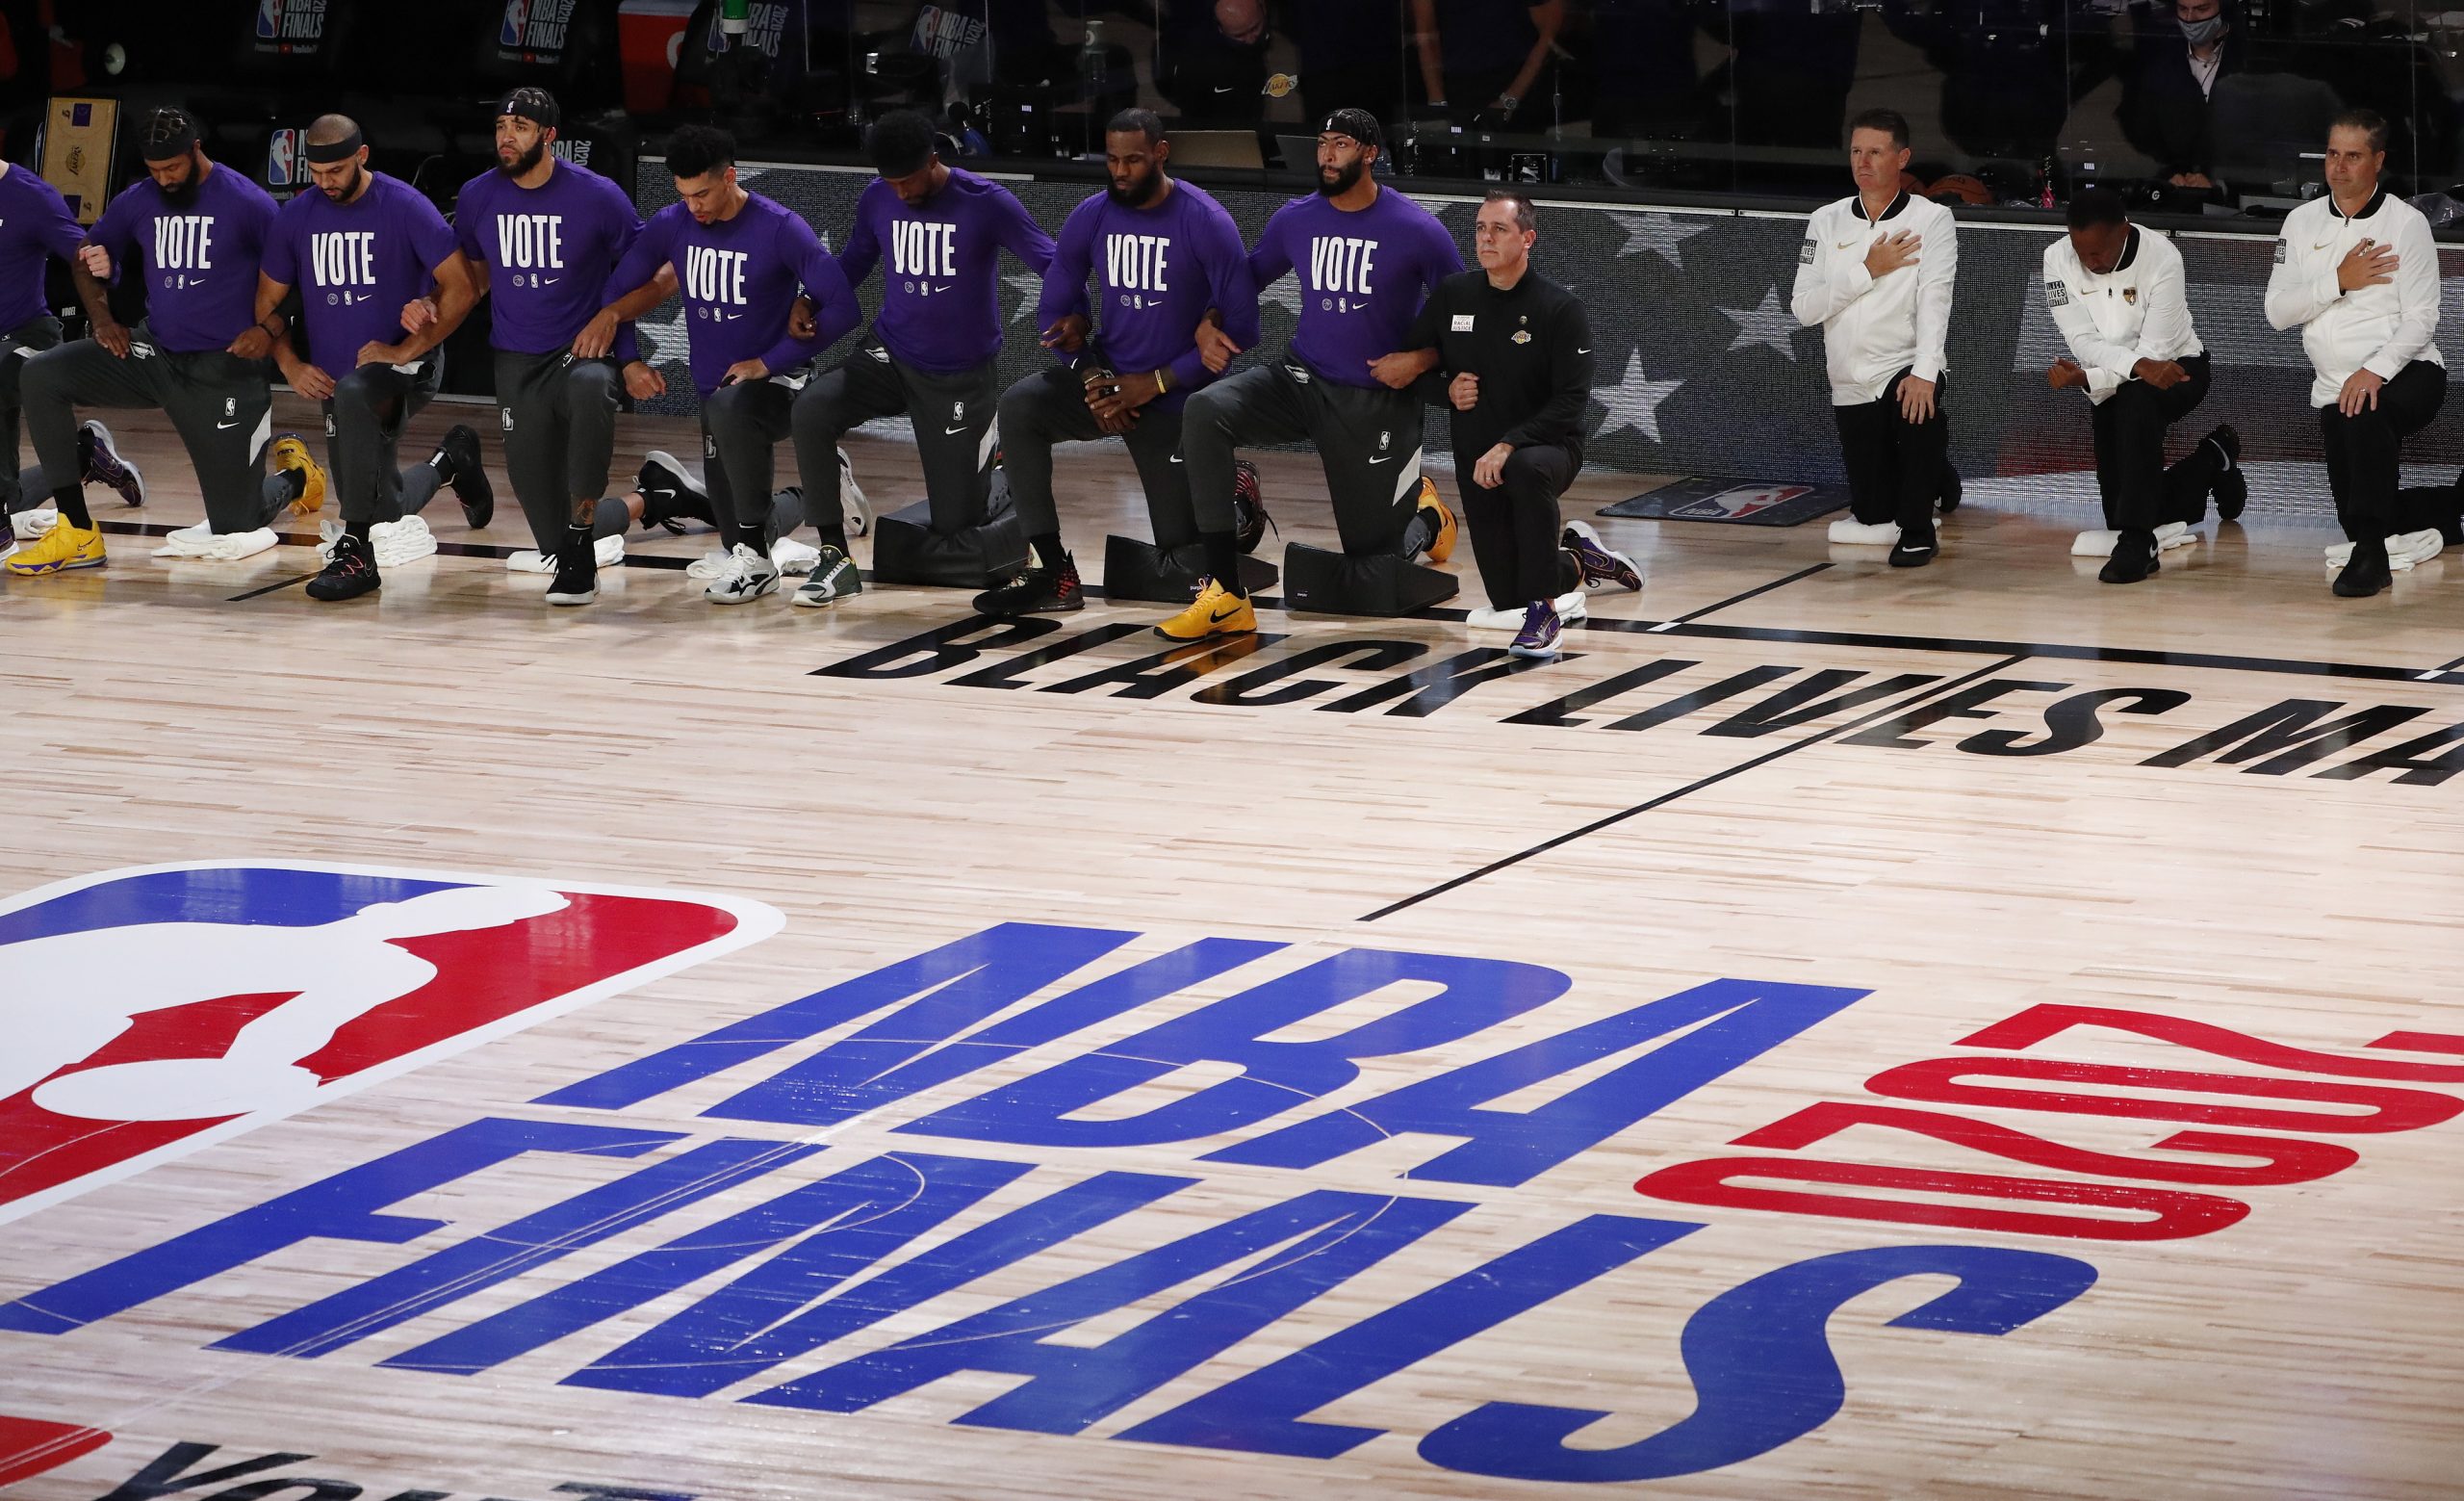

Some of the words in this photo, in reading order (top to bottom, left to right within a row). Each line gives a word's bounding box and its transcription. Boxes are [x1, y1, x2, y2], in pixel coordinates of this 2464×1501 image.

[282, 13, 324, 39] FINALS
[525, 20, 567, 49] FINALS
[770, 4, 789, 31] 2020
[937, 11, 969, 41] NBA
[154, 215, 215, 270] VOTE
[311, 231, 376, 287] VOTE
[497, 214, 564, 269] VOTE
[892, 220, 957, 276] VOTE
[1107, 234, 1170, 292] VOTE
[1311, 236, 1378, 295] VOTE
[686, 245, 748, 305] VOTE
[2047, 288, 2066, 299] LIVES
[807, 612, 1586, 717] BLACK
[1499, 657, 2193, 756] LIVES
[526, 921, 1874, 1189] NBA
[1633, 1003, 2464, 1240] 2020
[0, 1116, 2098, 1484] FINALS
